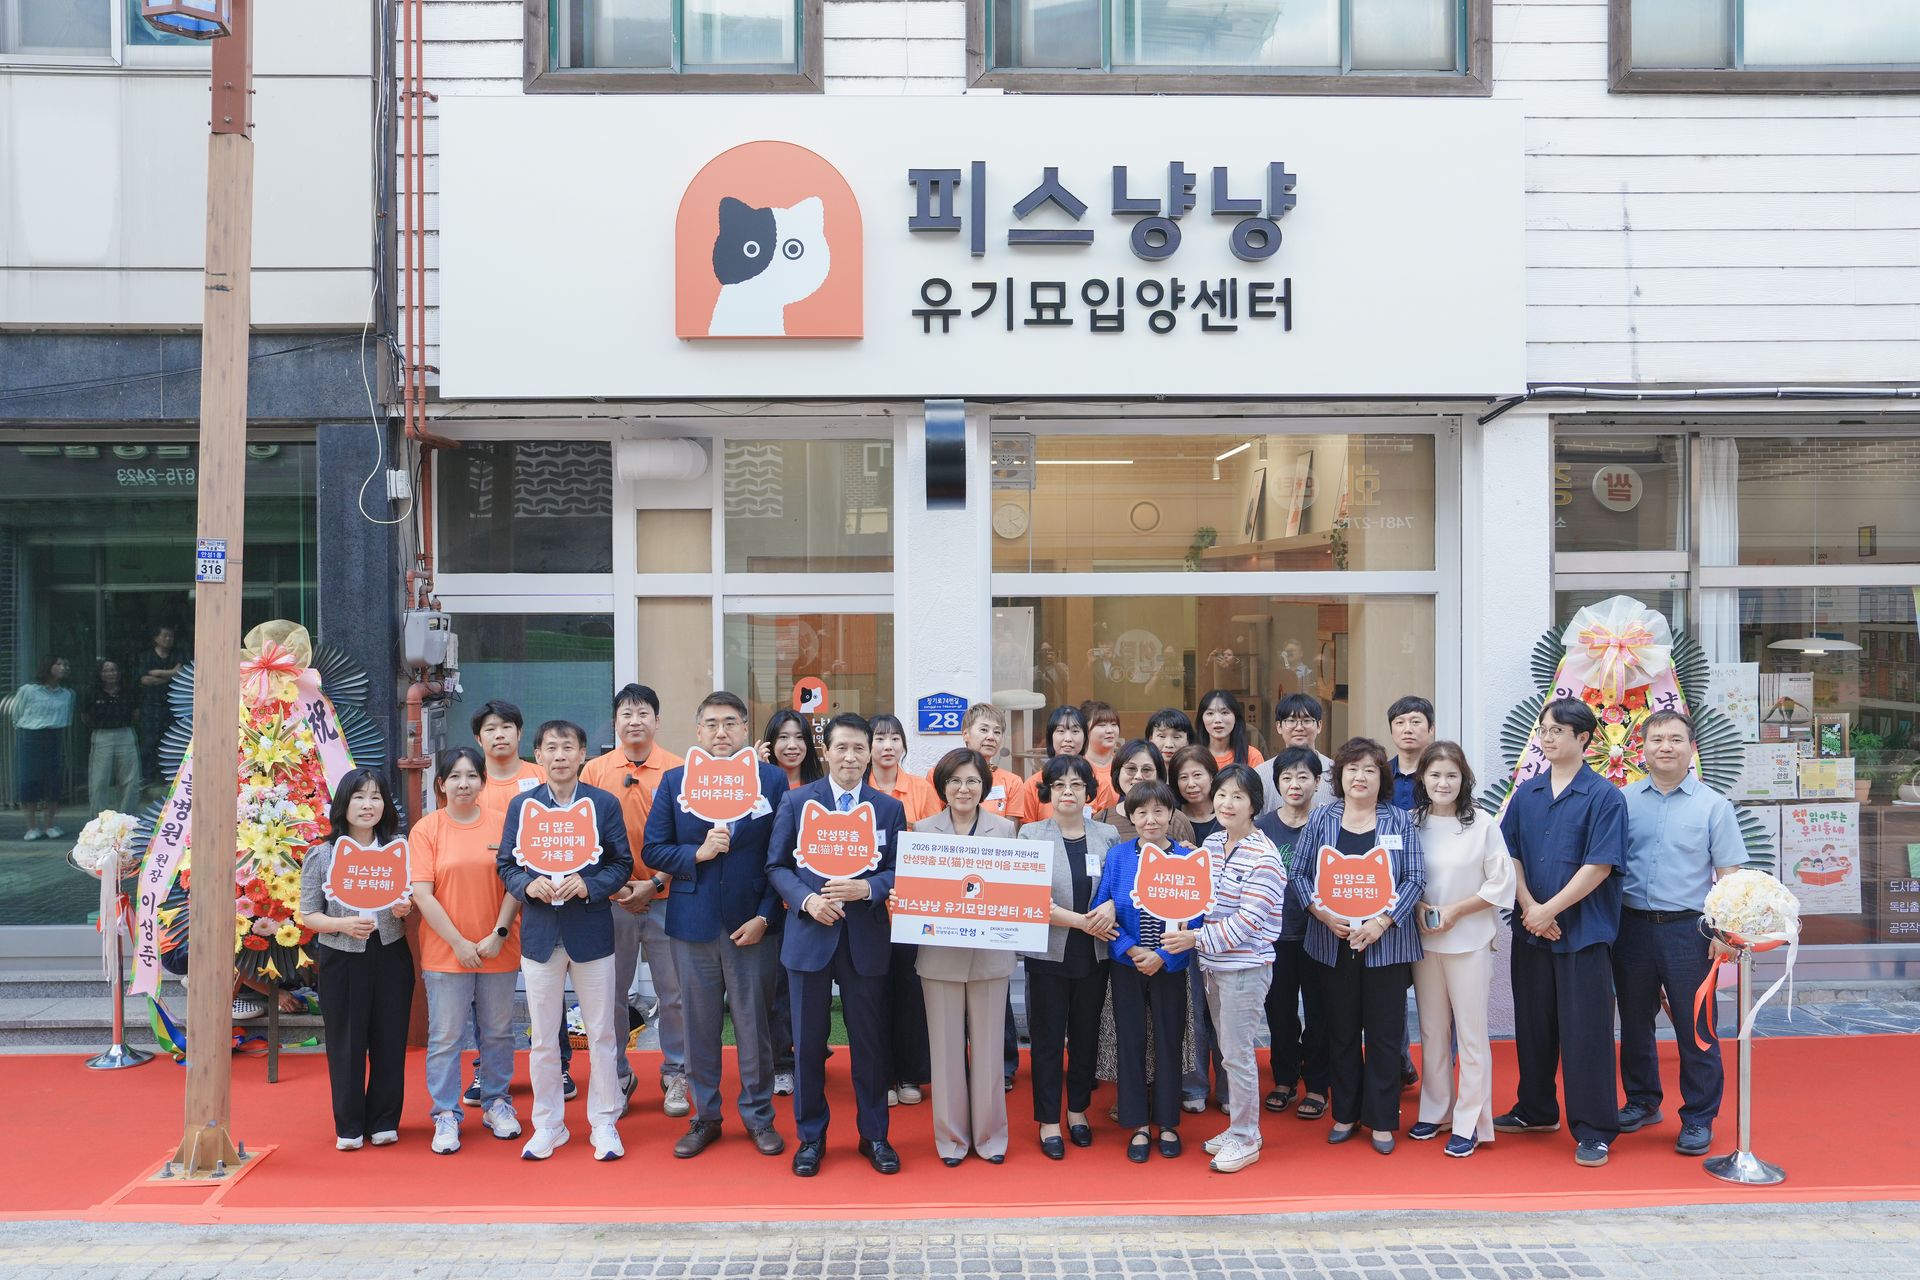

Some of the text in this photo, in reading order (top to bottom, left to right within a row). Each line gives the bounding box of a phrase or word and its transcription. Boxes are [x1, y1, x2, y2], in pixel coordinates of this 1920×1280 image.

[908, 160, 1297, 262] 피스냥냥
[911, 276, 1292, 334] 유기묘입양센터
[200, 564, 222, 575] 316
[305, 699, 339, 745] 祝
[928, 712, 959, 729] 28
[698, 775, 744, 787] 내 가족이
[690, 789, 752, 801] 되어주라옹~
[538, 821, 575, 833] 더 많은
[1801, 821, 1845, 837] 우리동네
[530, 835, 586, 848] 고양이에게
[816, 829, 860, 843] 안성맞춤
[541, 849, 575, 862] 가족을
[807, 843, 868, 857] 묘(猫)한 인연
[911, 843, 930, 852] 2026
[931, 844, 980, 855] 유기동물(유기묘)
[981, 848, 994, 856] 입양
[1014, 850, 1040, 859] 지원사업
[903, 854, 1047, 873] 안성맞춤 묘(猫)한 인연 이음 프로젝트
[347, 865, 393, 878] 피스냥냥
[343, 878, 394, 891] 잘 부탁해!
[1153, 872, 1196, 886] 사지말고
[1333, 873, 1377, 885] 입양으로
[1147, 886, 1200, 900] 입양하세요
[1331, 887, 1378, 899] 묘생역전!
[898, 899, 1044, 919] 피스냥냥 유기묘입양센터 개소
[959, 927, 977, 938] 안성
